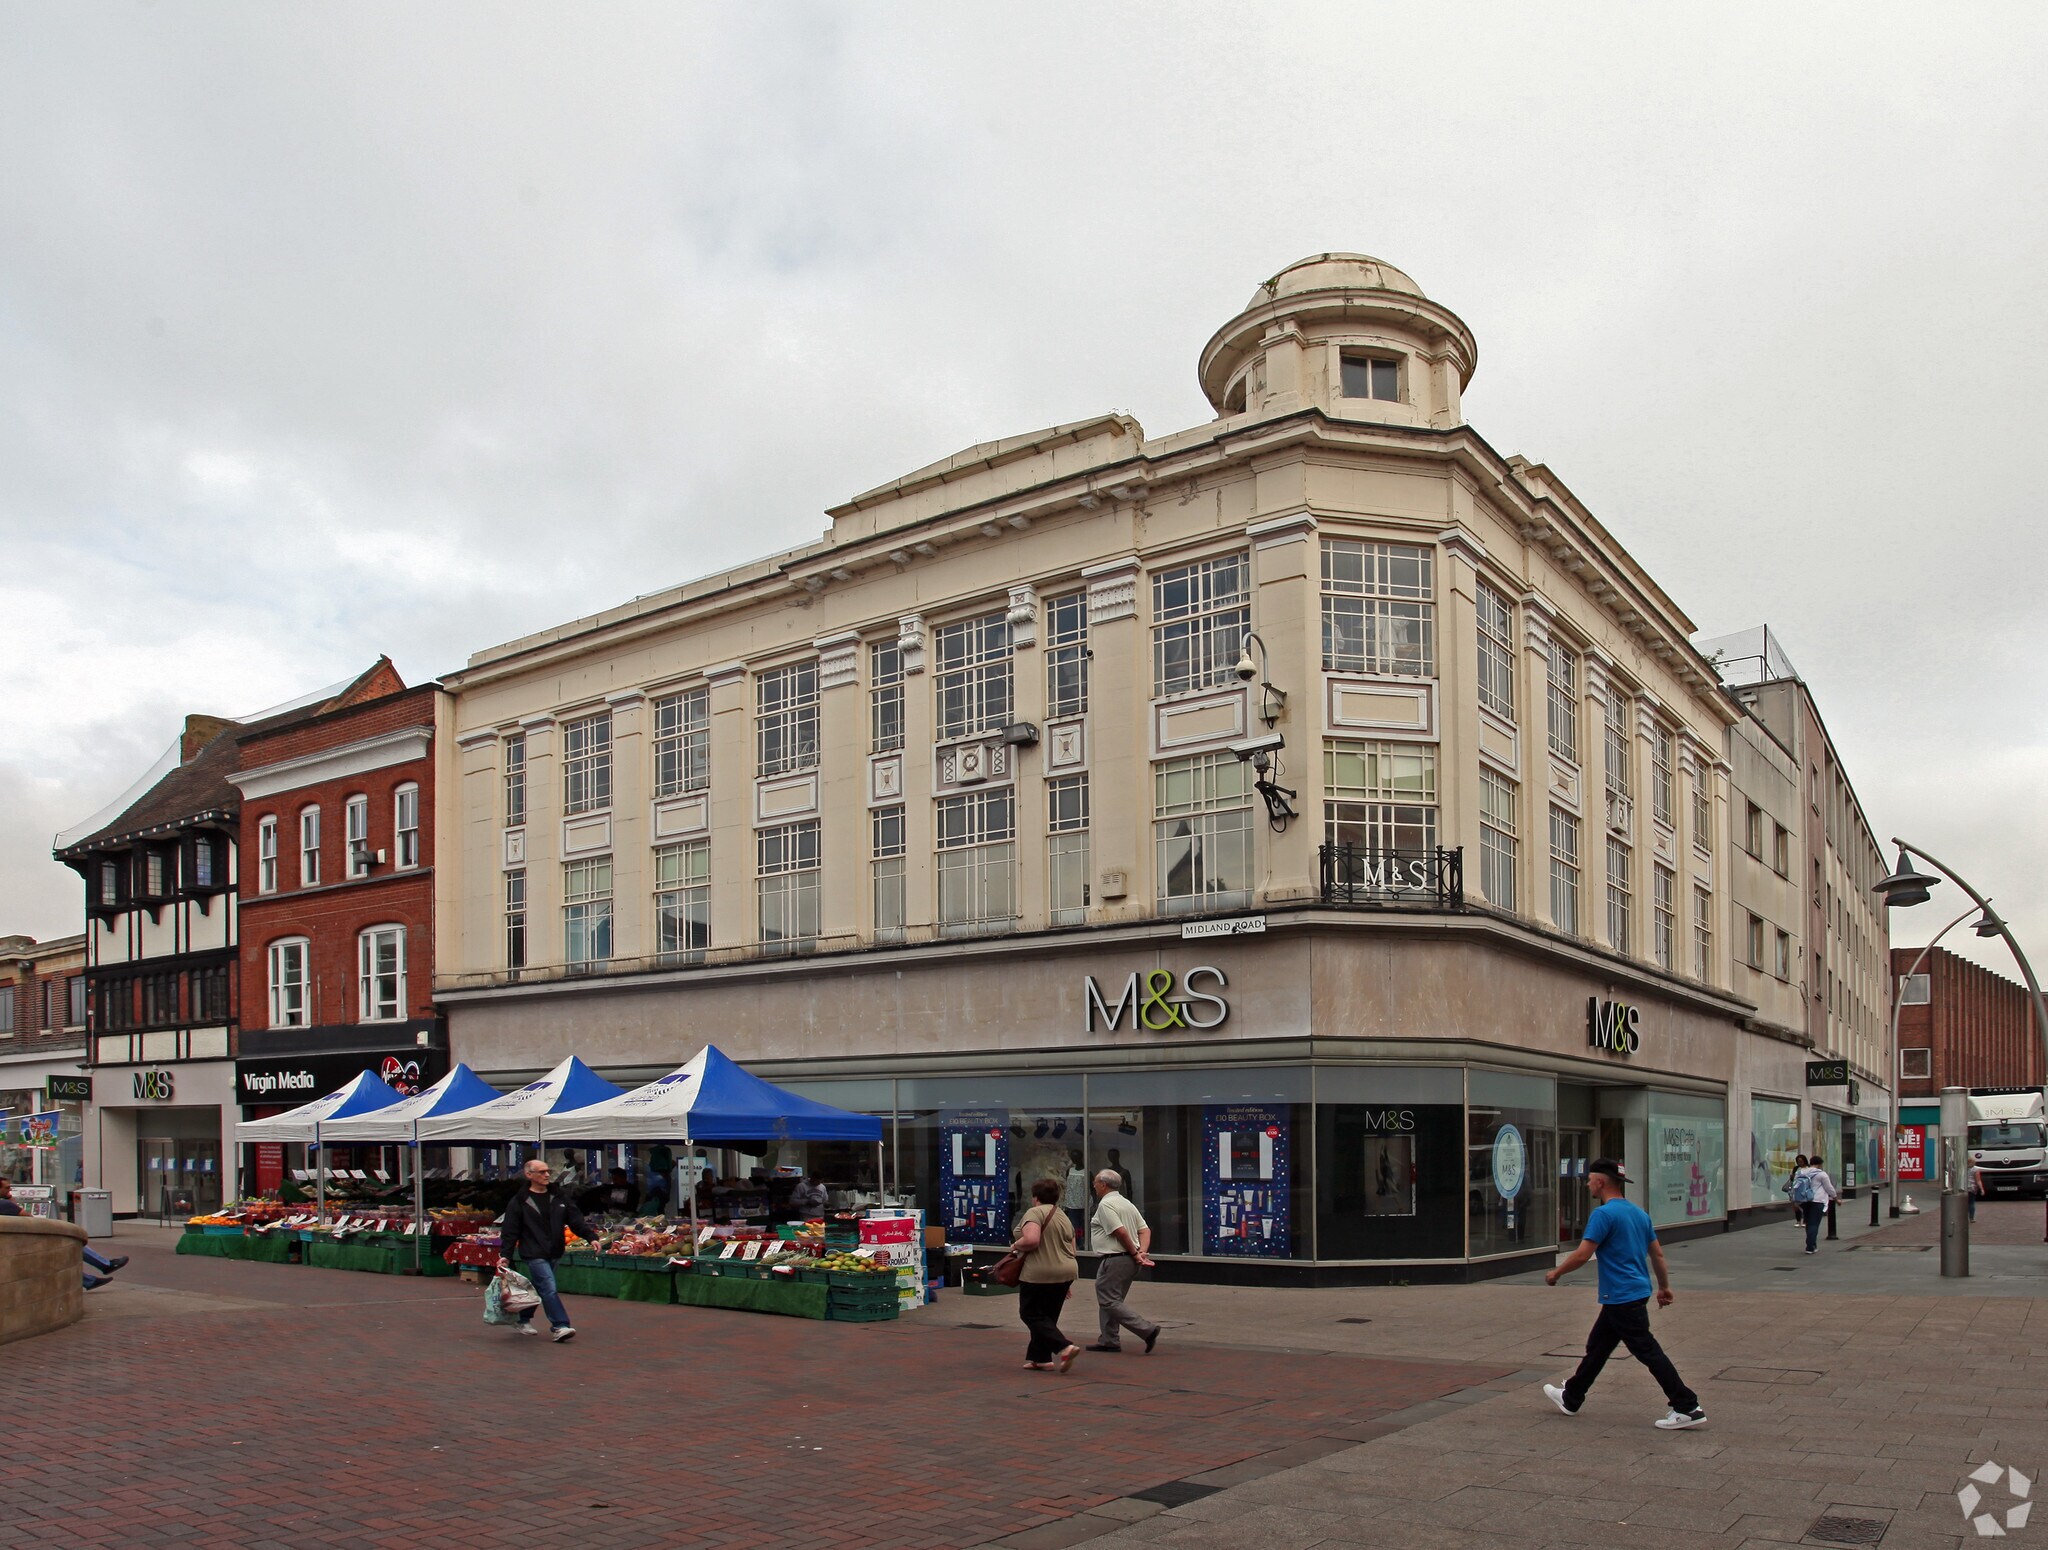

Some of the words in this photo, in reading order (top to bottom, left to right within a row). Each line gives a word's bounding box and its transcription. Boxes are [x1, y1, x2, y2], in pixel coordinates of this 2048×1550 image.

[1362, 858, 1426, 891] M&S
[1185, 923, 1231, 935] MIDLAND
[1235, 920, 1262, 931] ROAD
[1084, 965, 1229, 1032] M&S
[1593, 996, 1641, 1054] M&S
[244, 1072, 276, 1094] Virgin
[279, 1070, 315, 1089] Media
[1810, 1066, 1844, 1079] M&S
[53, 1081, 88, 1095] M&S
[133, 1070, 173, 1099] M&S
[1215, 1114, 1227, 1122] £10
[1228, 1113, 1258, 1122] BEAUTY
[1259, 1113, 1276, 1121] BOX
[1365, 1110, 1415, 1130] M&S
[1663, 1128, 1679, 1147] M&S
[1502, 1164, 1517, 1177] M&S
